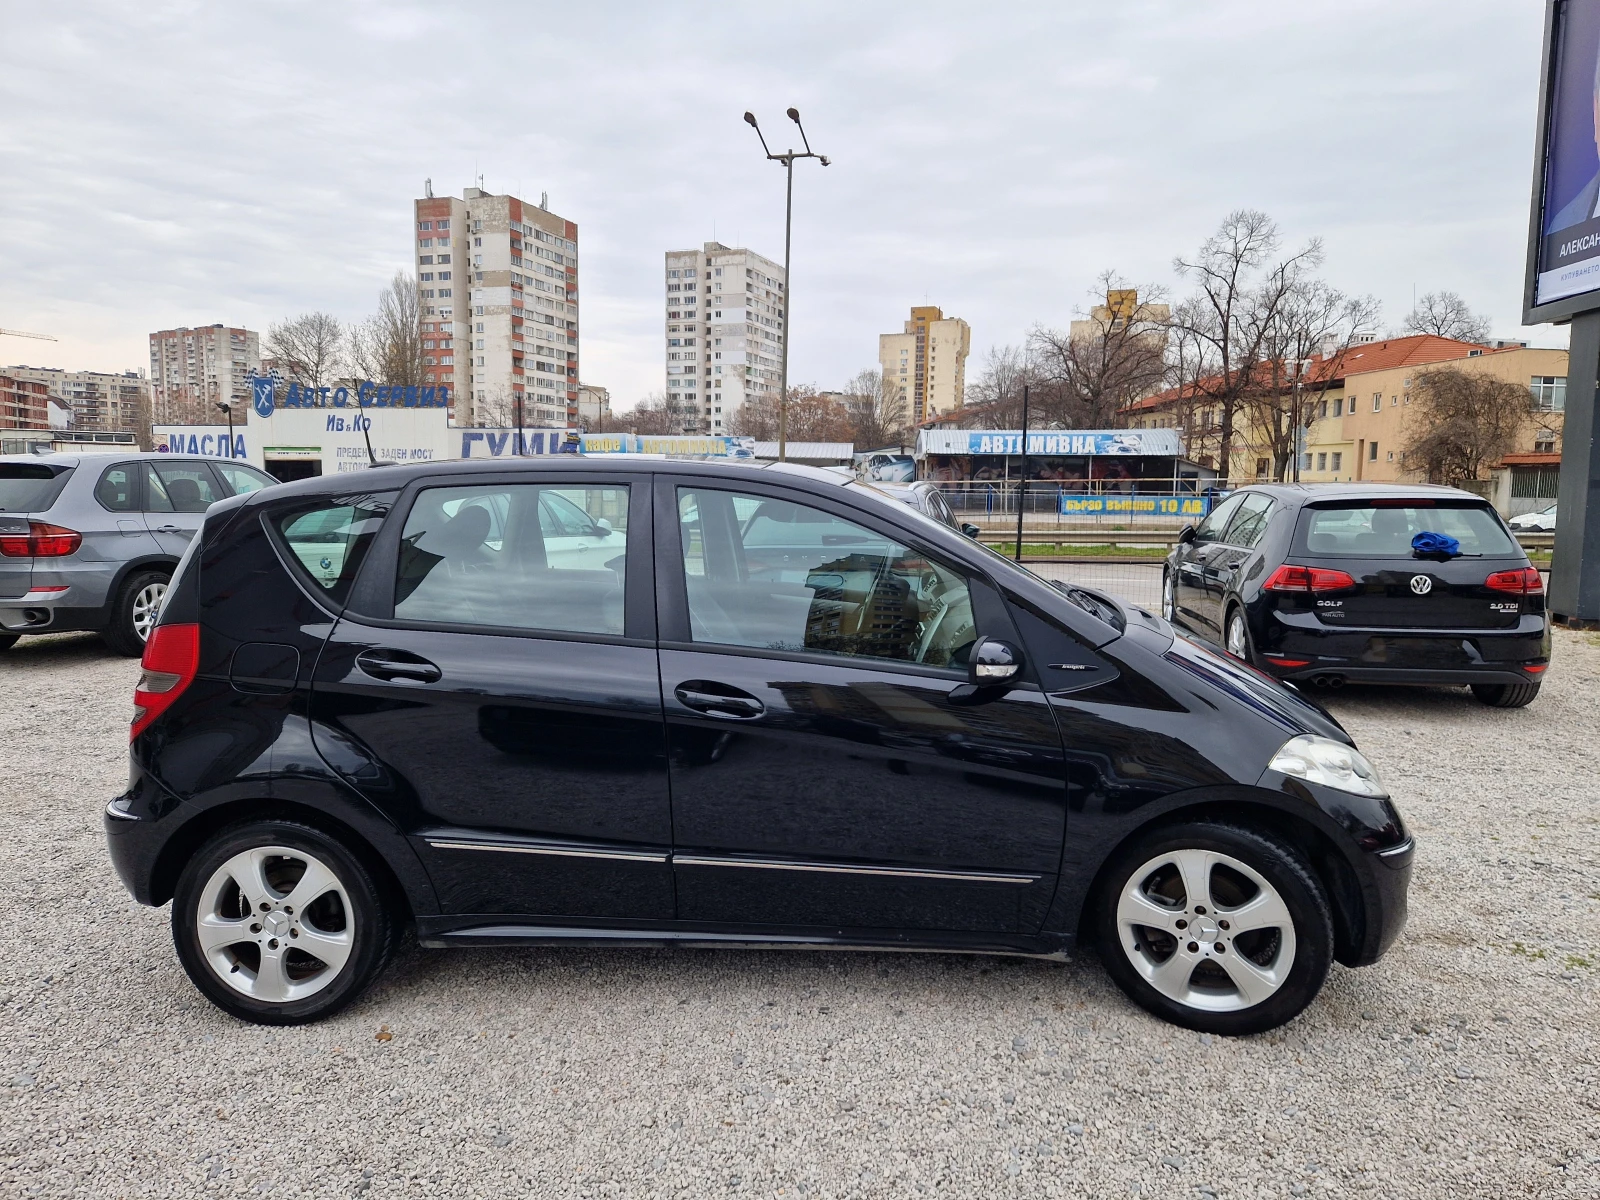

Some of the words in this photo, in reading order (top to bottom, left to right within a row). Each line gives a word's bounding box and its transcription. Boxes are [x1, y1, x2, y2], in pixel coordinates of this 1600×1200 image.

[1560, 264, 1600, 281] КУПУВАНЕТО
[169, 433, 247, 459] МАСЛА
[642, 439, 728, 455] АВТОМИВКА
[979, 435, 1097, 454] АВТОМИВКА
[336, 447, 368, 459] ПРЕДЕН
[381, 448, 407, 460] ЗАДЕН
[410, 448, 433, 460] МОСТ
[1066, 499, 1103, 511] БЪРЗО
[1159, 498, 1178, 513] 10
